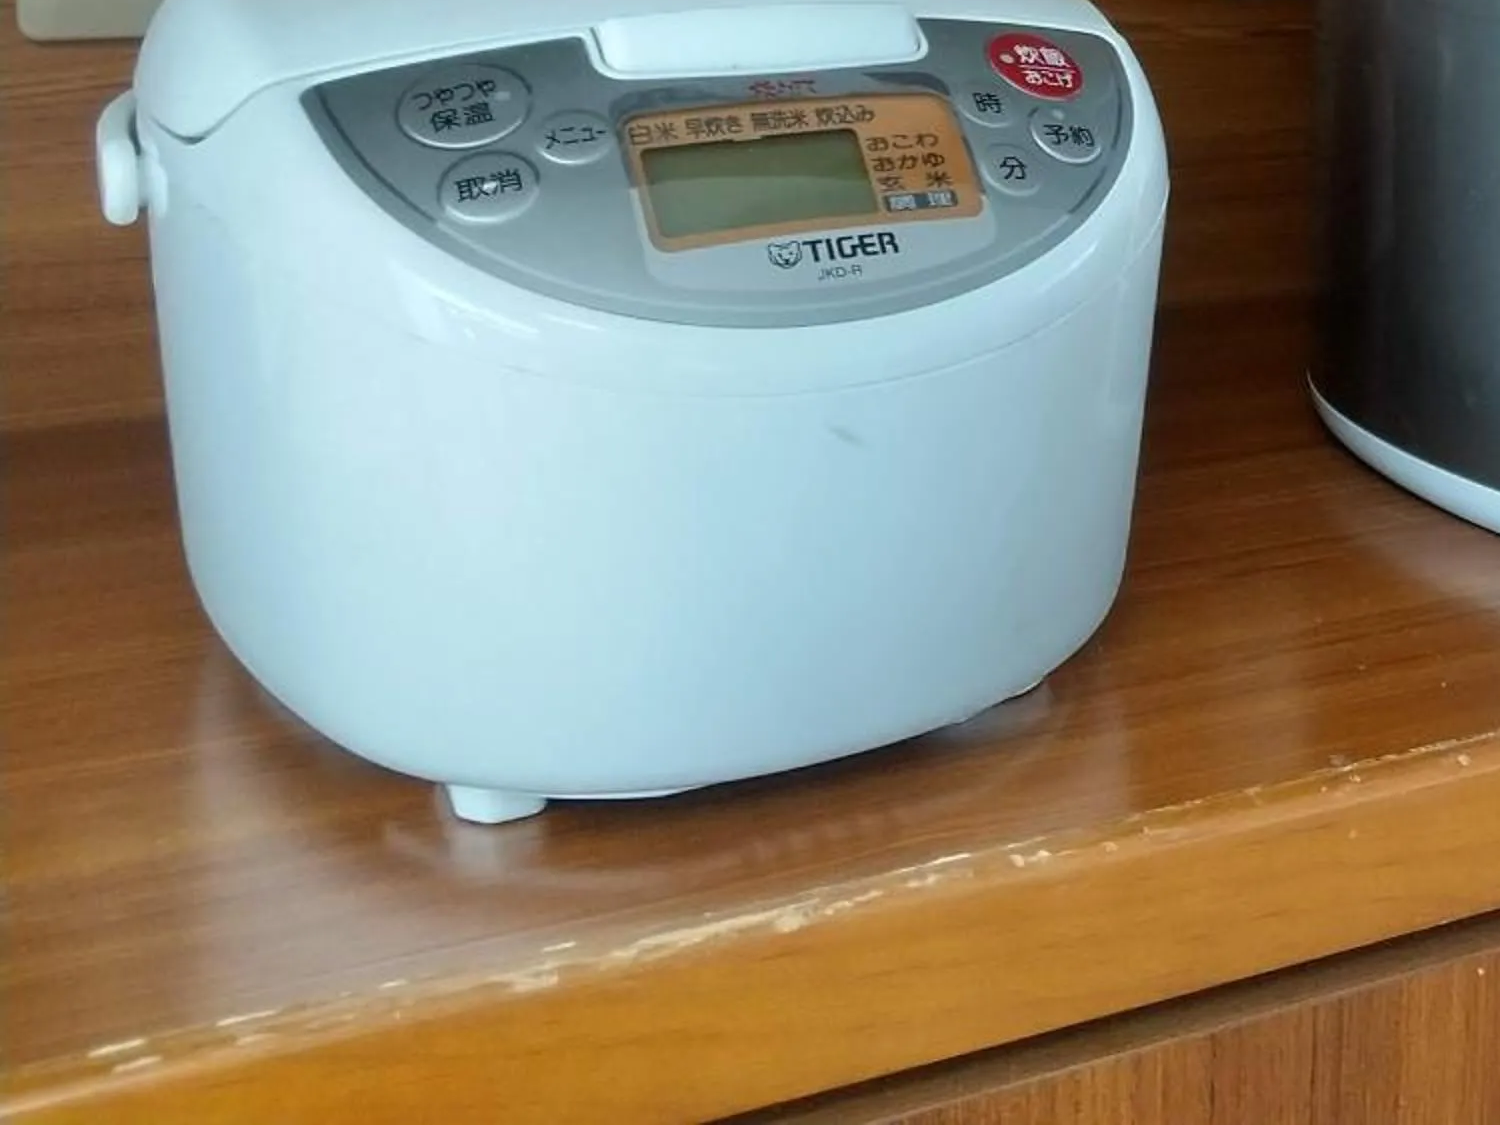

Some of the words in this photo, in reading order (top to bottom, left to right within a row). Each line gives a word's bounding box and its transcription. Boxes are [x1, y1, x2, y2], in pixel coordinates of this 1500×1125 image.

[412, 79, 497, 111] つやつや
[973, 92, 1002, 114] 時
[430, 102, 495, 133] 保温
[627, 122, 679, 146] 白米
[684, 115, 745, 140] 早炊き
[865, 133, 939, 152] おこわ
[1043, 124, 1095, 147] 予約
[870, 152, 946, 172] おかゆ
[1000, 156, 1027, 180] 分
[455, 168, 524, 203] 取消
[802, 231, 900, 263] TIGER
[817, 264, 863, 281] JKD-R
